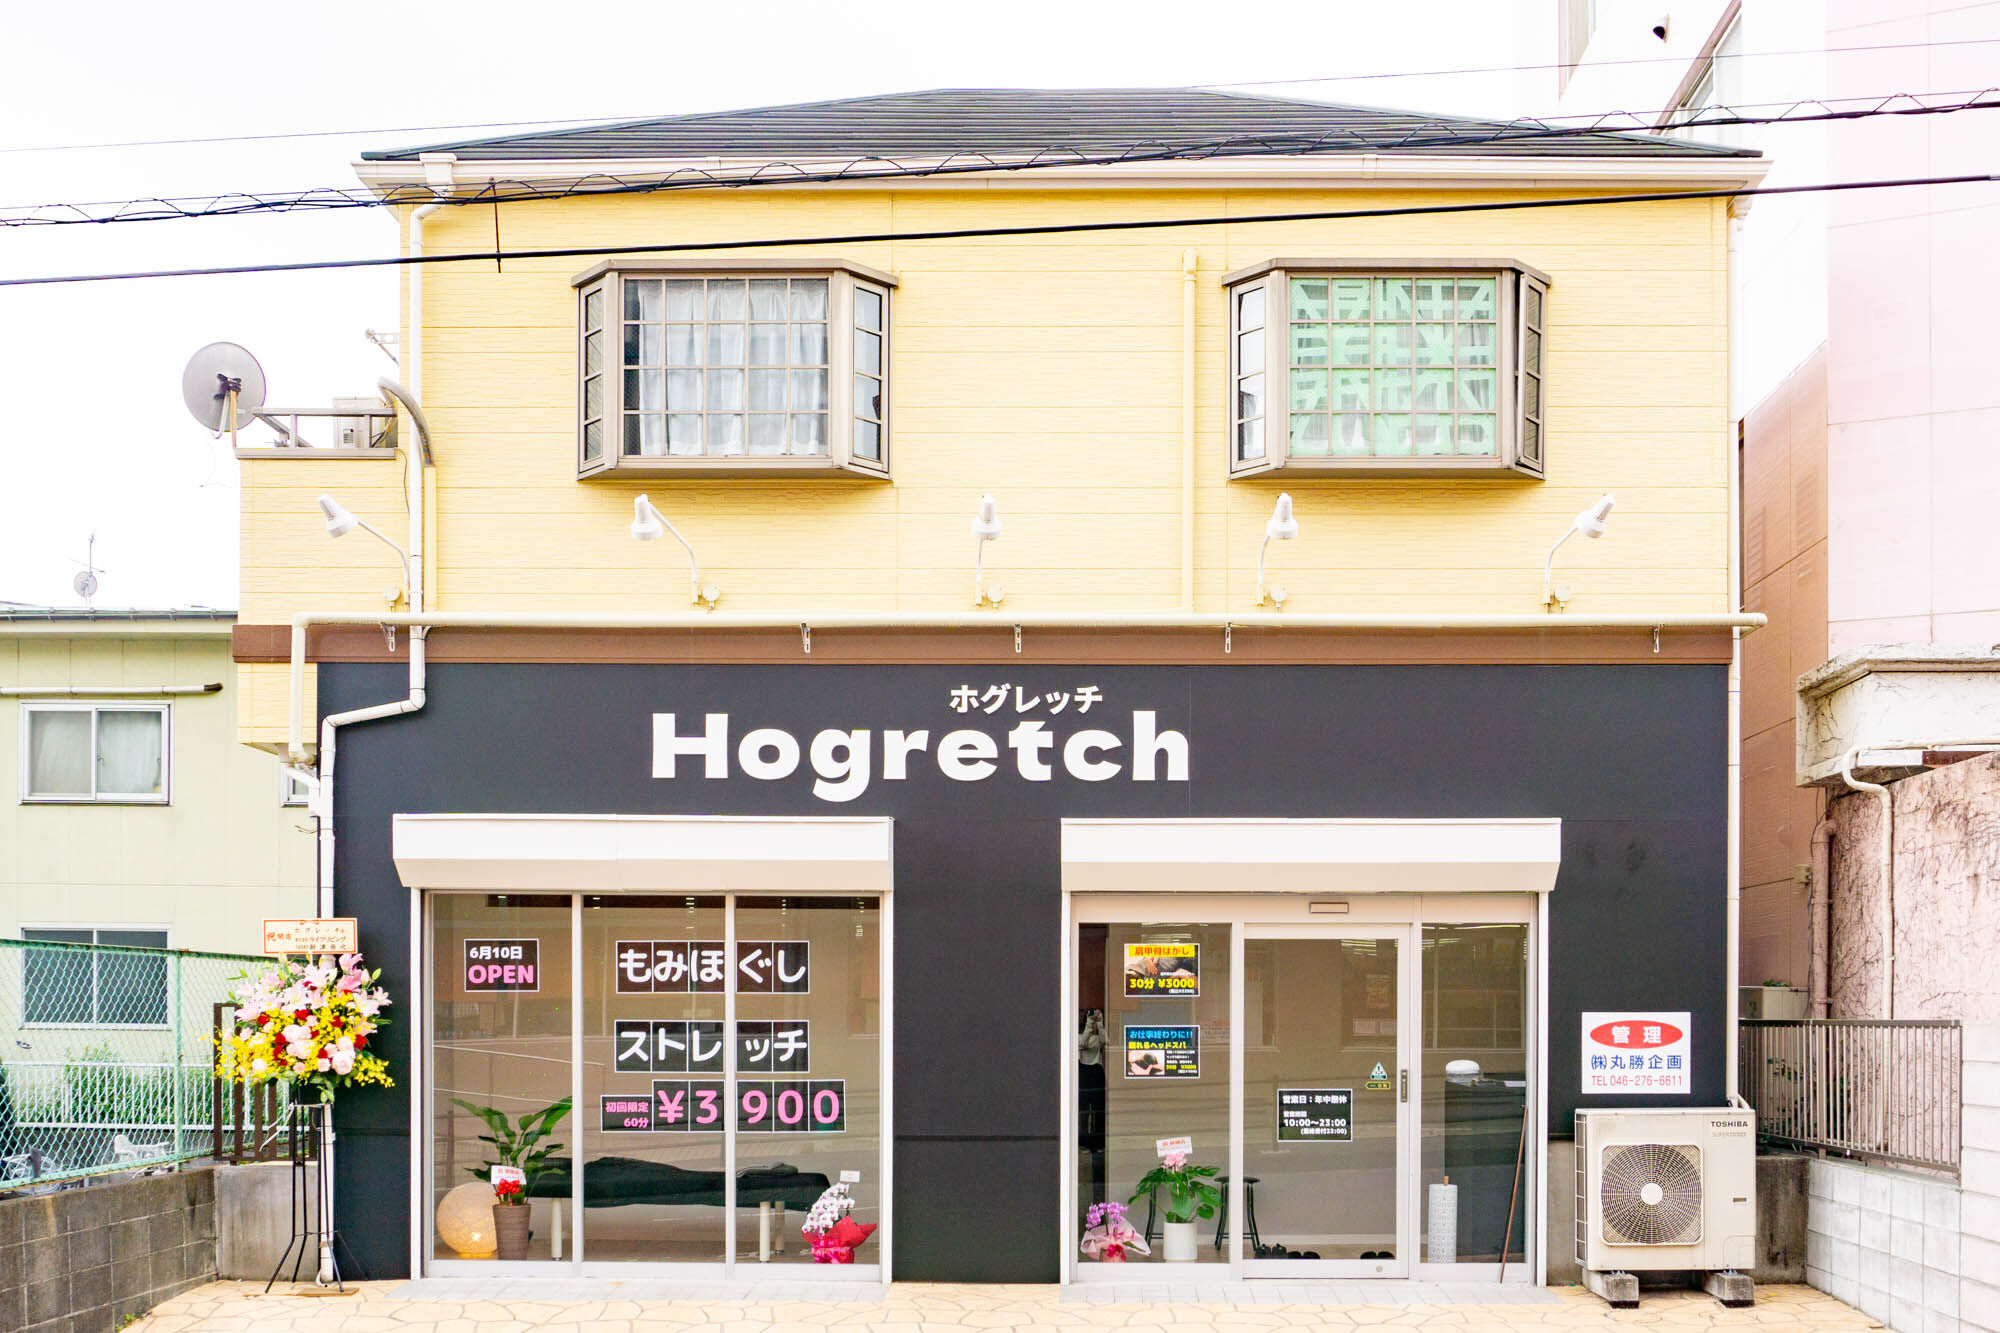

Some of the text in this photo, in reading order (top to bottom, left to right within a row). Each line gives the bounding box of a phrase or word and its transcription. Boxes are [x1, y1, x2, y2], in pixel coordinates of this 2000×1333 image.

[949, 684, 1103, 714] ホグレッチ
[652, 710, 1190, 803] Hogretch
[469, 945, 523, 960] 6月10日
[468, 964, 535, 984] OPEN
[618, 948, 807, 984] もみほぐし
[1129, 978, 1155, 990] 30分
[617, 1028, 808, 1063] ストレッチ
[1591, 1075, 1608, 1087] TEL
[605, 1101, 649, 1113] 初回限定
[657, 1088, 841, 1125] ¥3900
[623, 1117, 649, 1128] 60分
